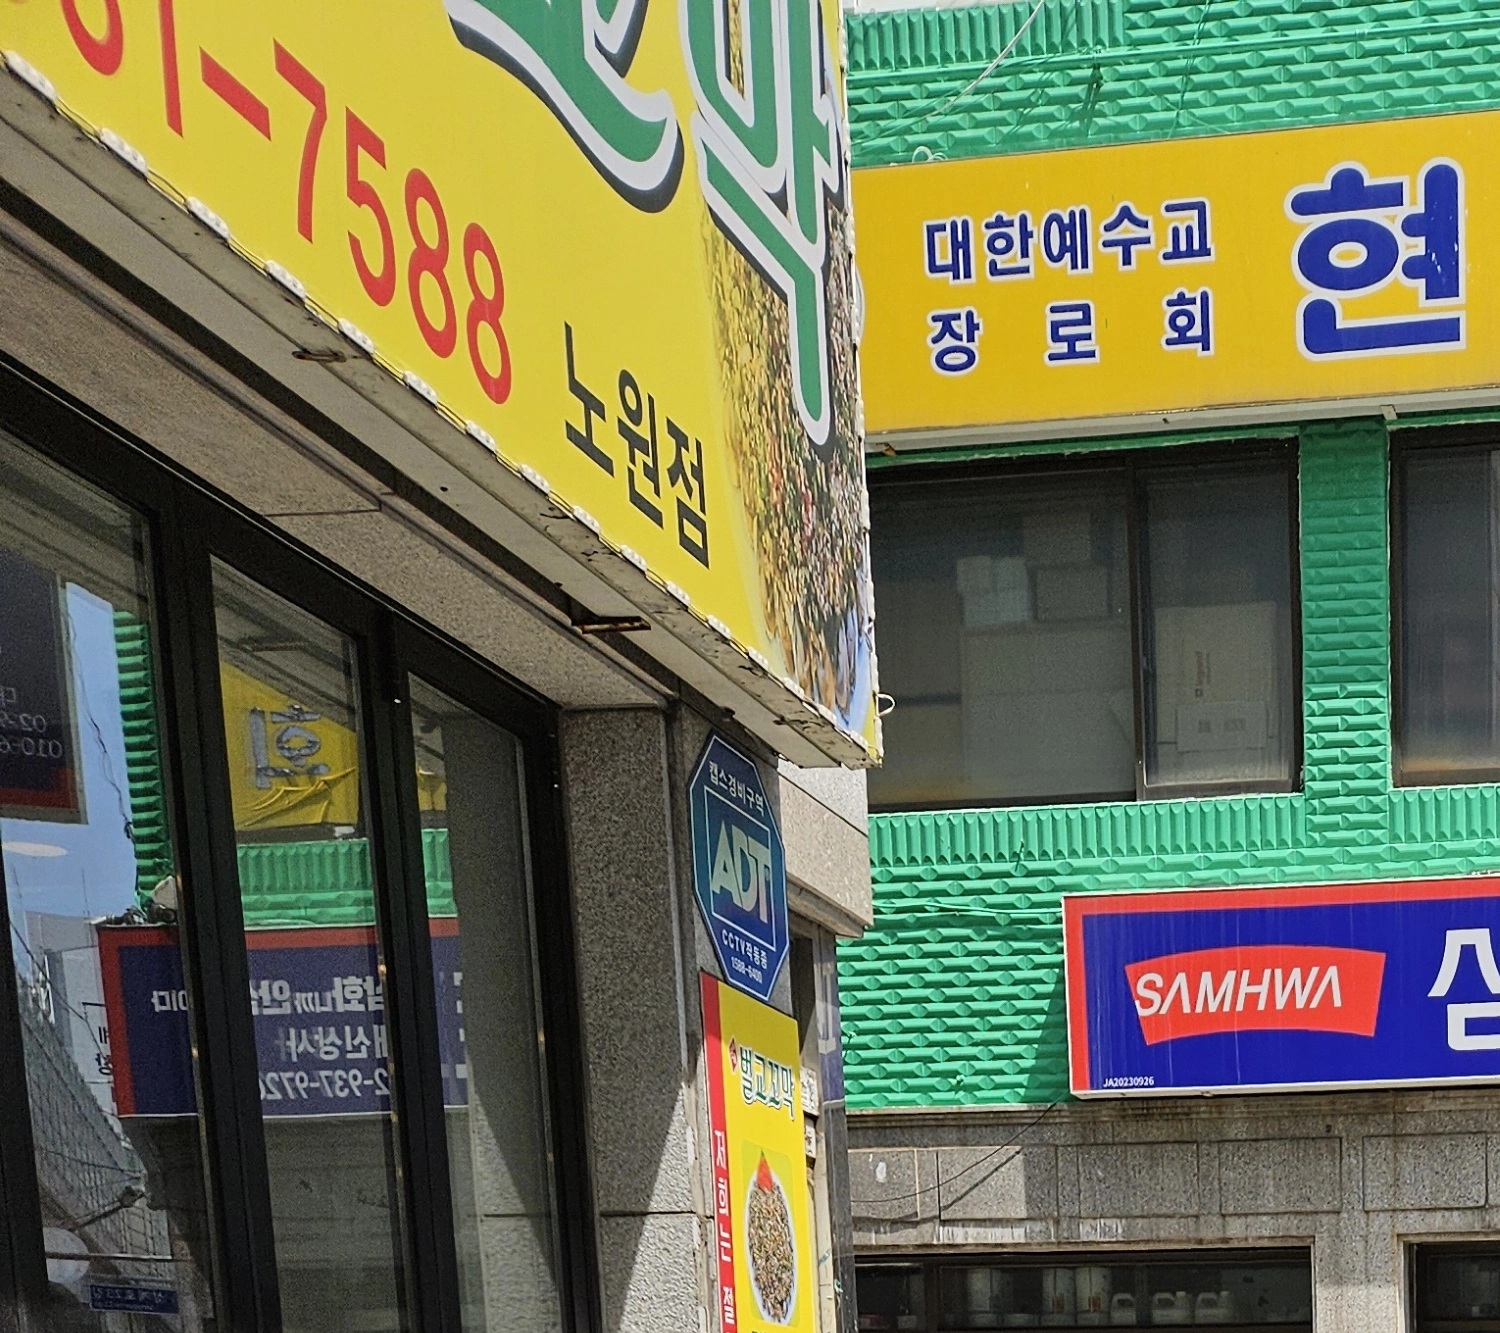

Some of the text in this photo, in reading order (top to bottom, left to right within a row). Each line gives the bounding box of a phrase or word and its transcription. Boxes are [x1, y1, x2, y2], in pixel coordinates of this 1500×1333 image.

[923, 198, 1213, 284] 대한예수교
[564, 322, 710, 570] 노원점
[708, 761, 765, 817] 캡스경비구역
[711, 819, 770, 924] ADT
[721, 929, 768, 969] CCTV작동중
[1134, 964, 1343, 1018] SAMHWA
[738, 1044, 796, 1121] 벌교꼬막
[1102, 1077, 1155, 1089] JA20230926
